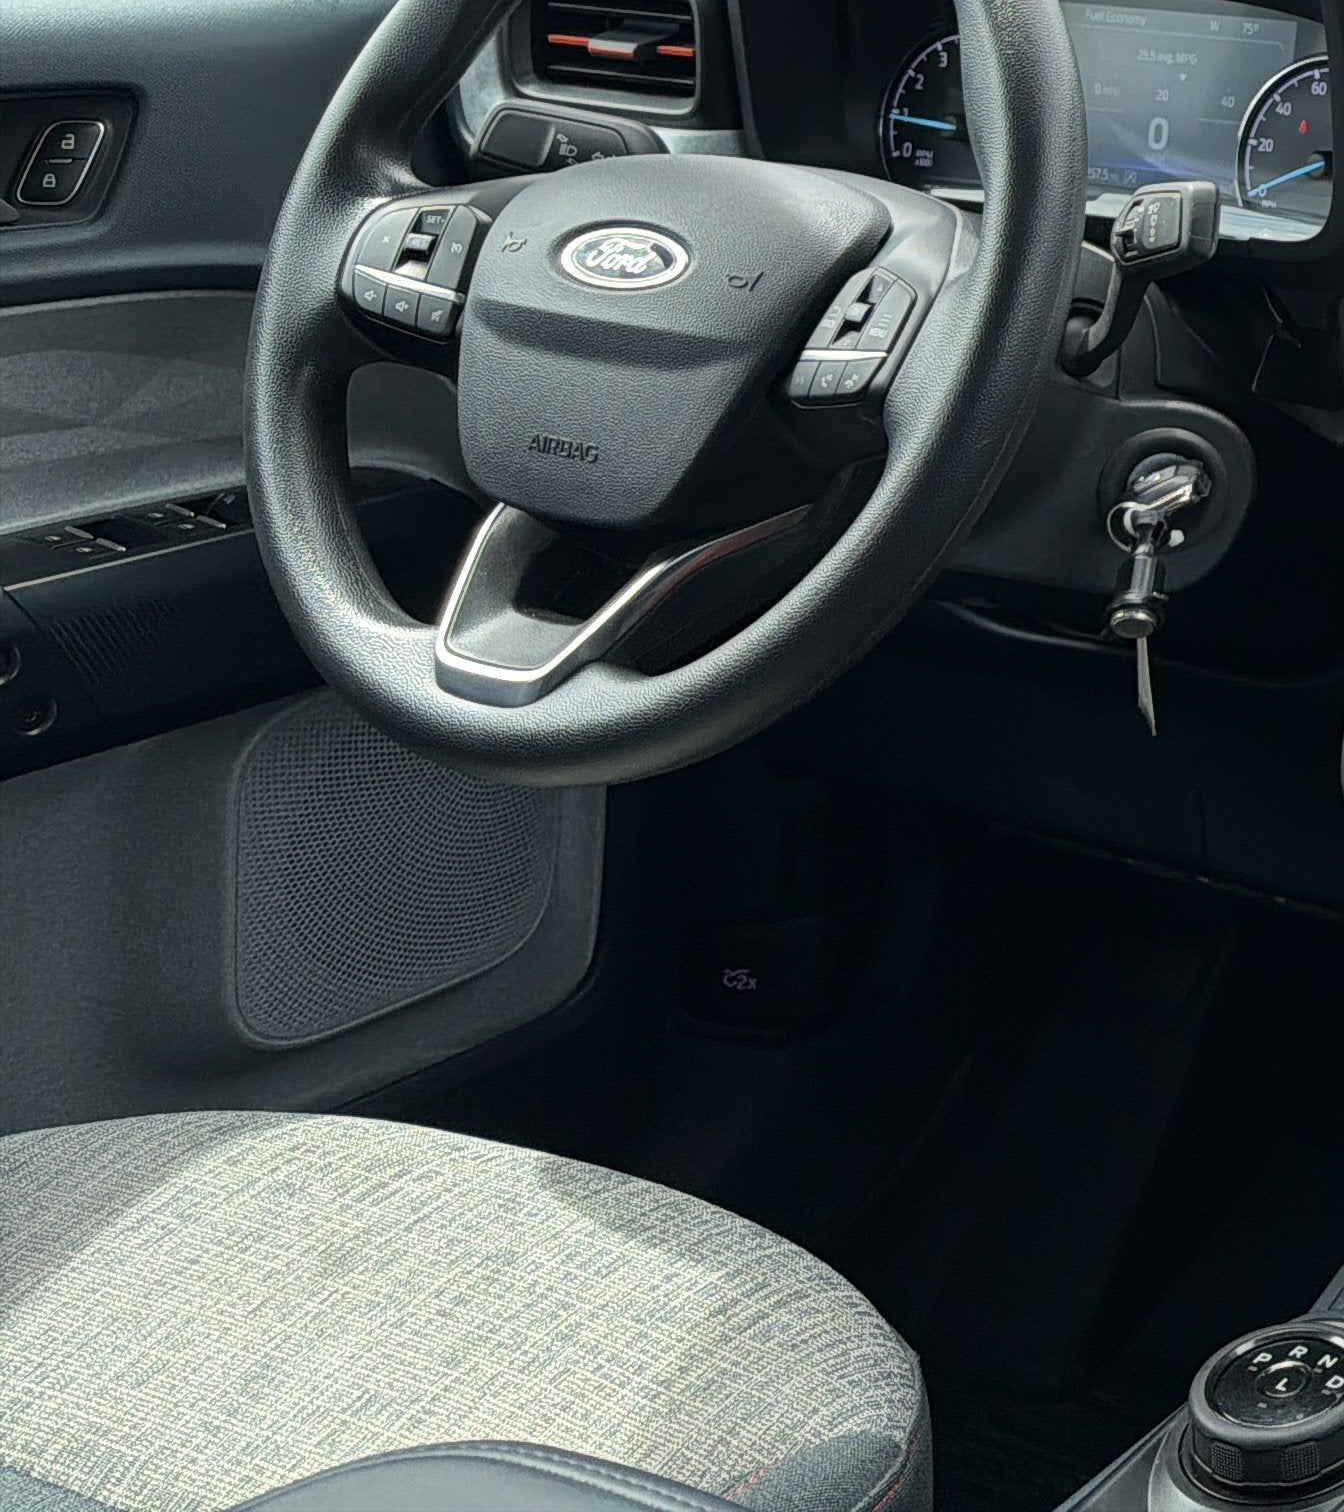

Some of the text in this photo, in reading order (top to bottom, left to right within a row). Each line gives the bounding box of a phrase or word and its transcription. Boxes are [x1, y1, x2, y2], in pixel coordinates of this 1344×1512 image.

[1104, 11, 1147, 27] Economy
[938, 51, 948, 68] 3
[915, 73, 925, 90] 2
[1311, 81, 1327, 96] 60
[1155, 89, 1169, 101] 20
[1221, 95, 1235, 108] 40
[1275, 102, 1292, 116] 40
[1148, 116, 1169, 150] 0
[902, 141, 913, 158] 0
[1257, 137, 1274, 152] 20
[585, 237, 658, 275] Ford
[526, 432, 601, 465] AIRBAG
[1253, 1345, 1338, 1369] P R N
[1275, 1375, 1344, 1391] L D
